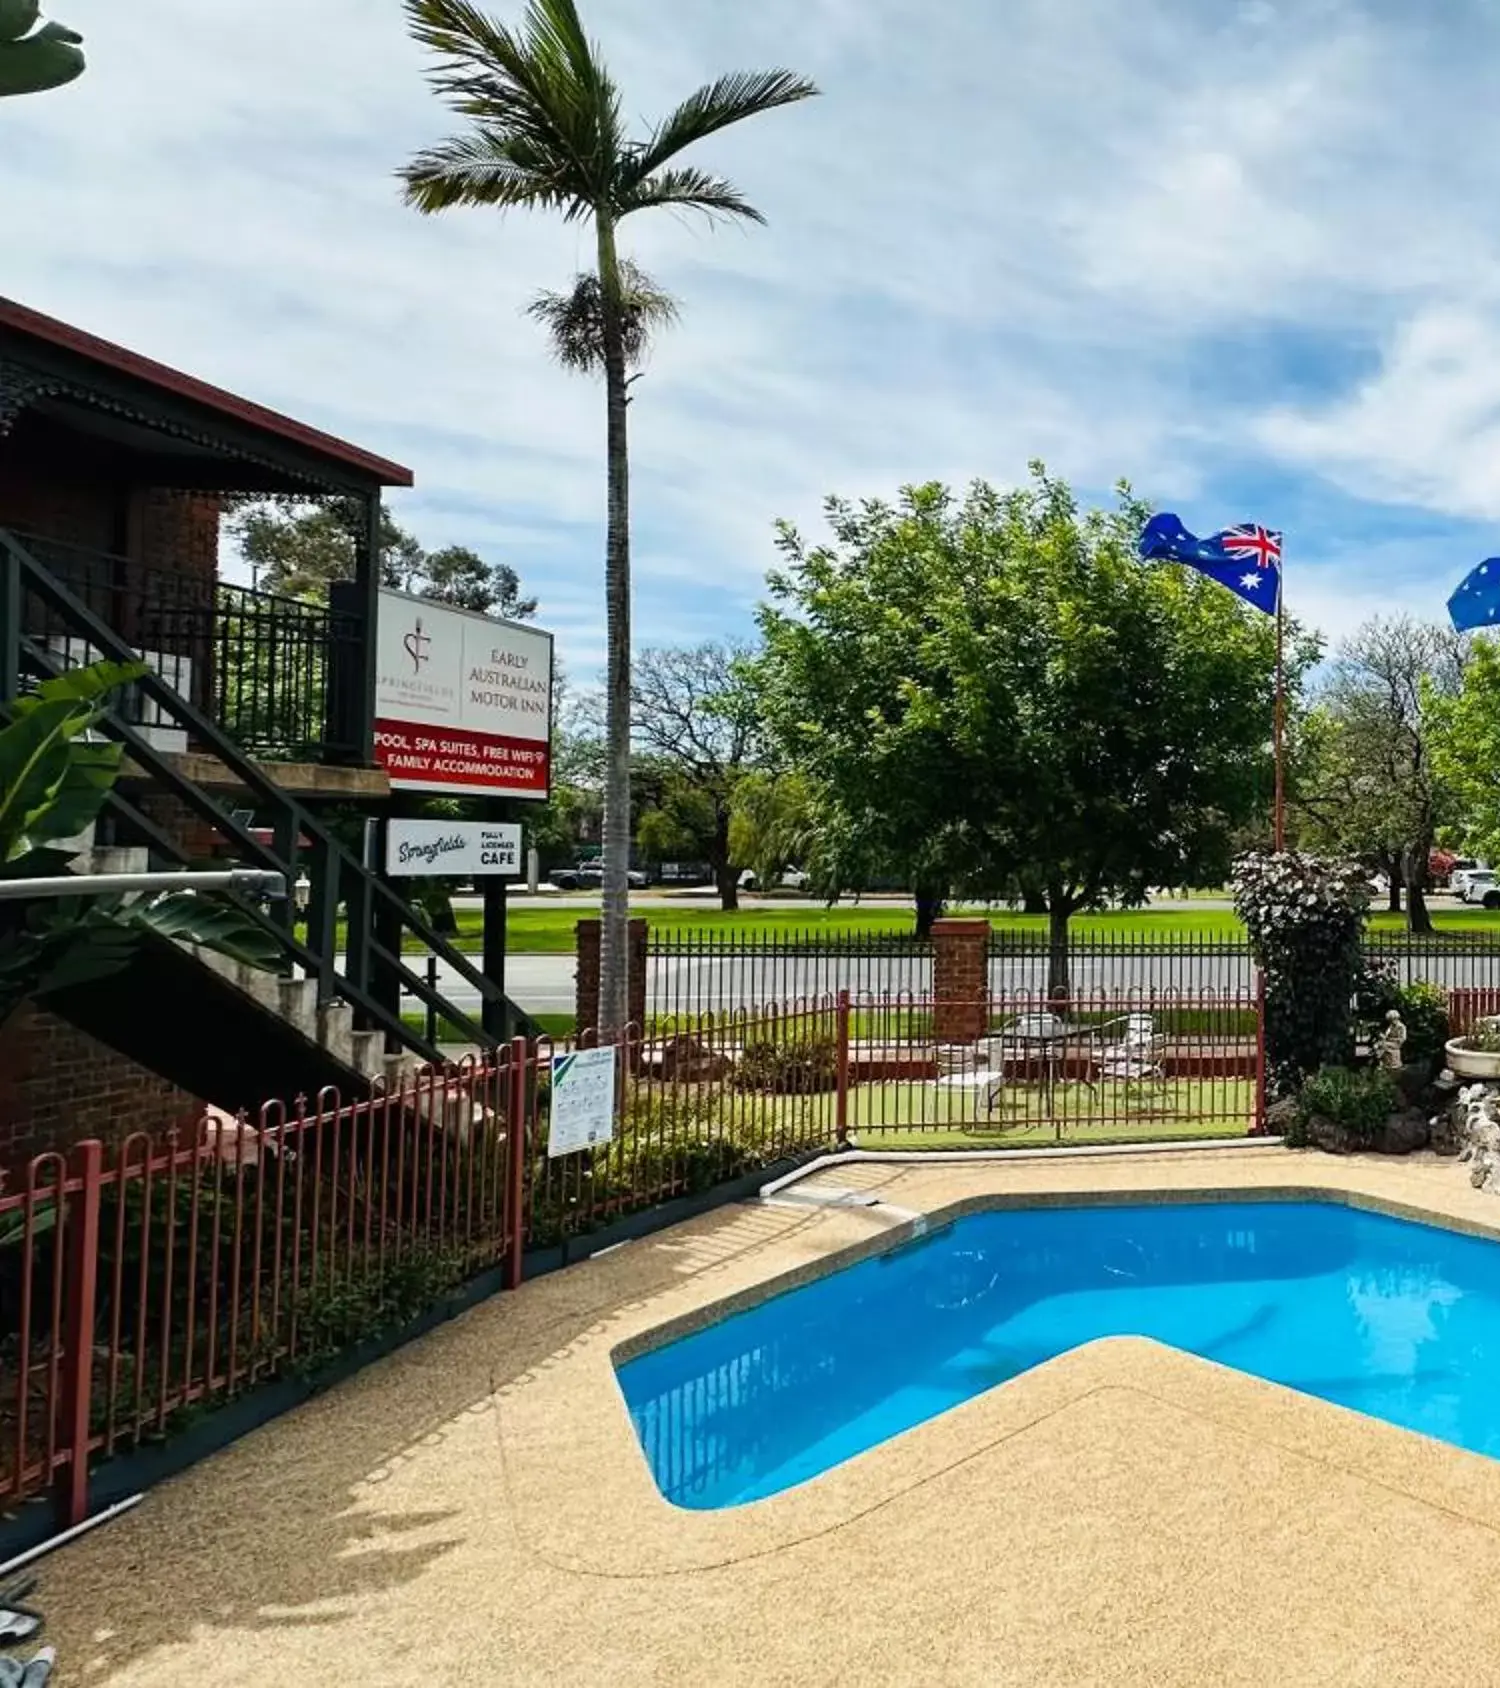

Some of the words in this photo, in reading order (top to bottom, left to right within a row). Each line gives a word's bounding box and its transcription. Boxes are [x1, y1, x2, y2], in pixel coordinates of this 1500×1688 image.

[491, 648, 529, 669] EARLY
[469, 667, 547, 693] AUSTRALIAN
[470, 690, 518, 711] MOTOR
[521, 698, 545, 713] INN
[373, 732, 412, 751] POOL,
[414, 737, 437, 753] SPA
[482, 745, 509, 761] FREE
[386, 753, 431, 770] FAMILY
[433, 758, 535, 779] ACCOMMODATION
[480, 831, 505, 839] FULLY
[480, 851, 515, 865] CAFE
